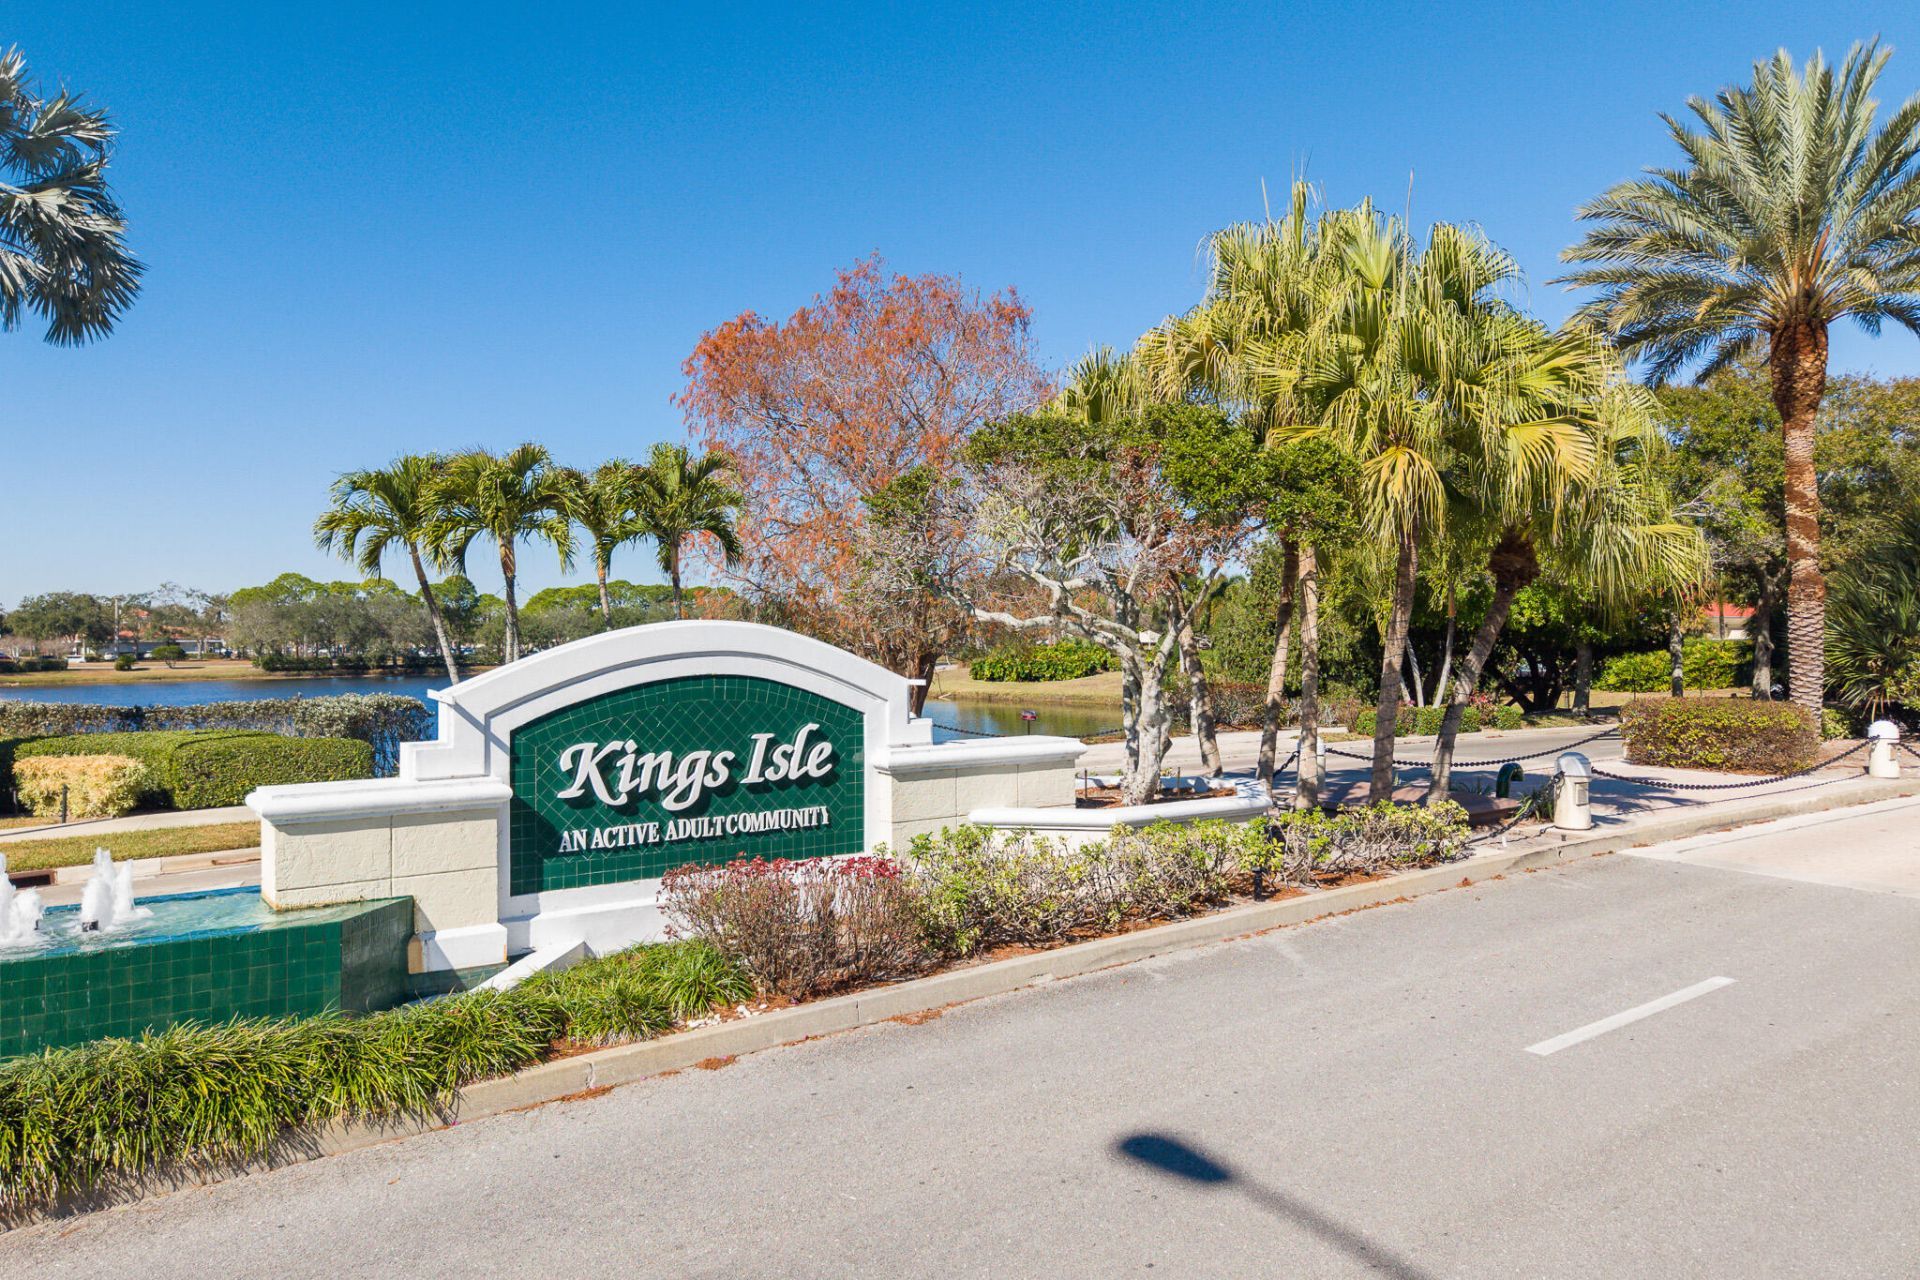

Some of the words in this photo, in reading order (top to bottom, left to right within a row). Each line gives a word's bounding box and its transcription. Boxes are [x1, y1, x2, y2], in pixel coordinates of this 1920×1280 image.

[557, 739, 735, 811] Kings
[740, 722, 833, 784] Isle
[558, 828, 588, 853] AN
[590, 821, 660, 850] ACTIVE
[664, 815, 725, 842] ADULT
[726, 805, 831, 835] COMMUNITY
